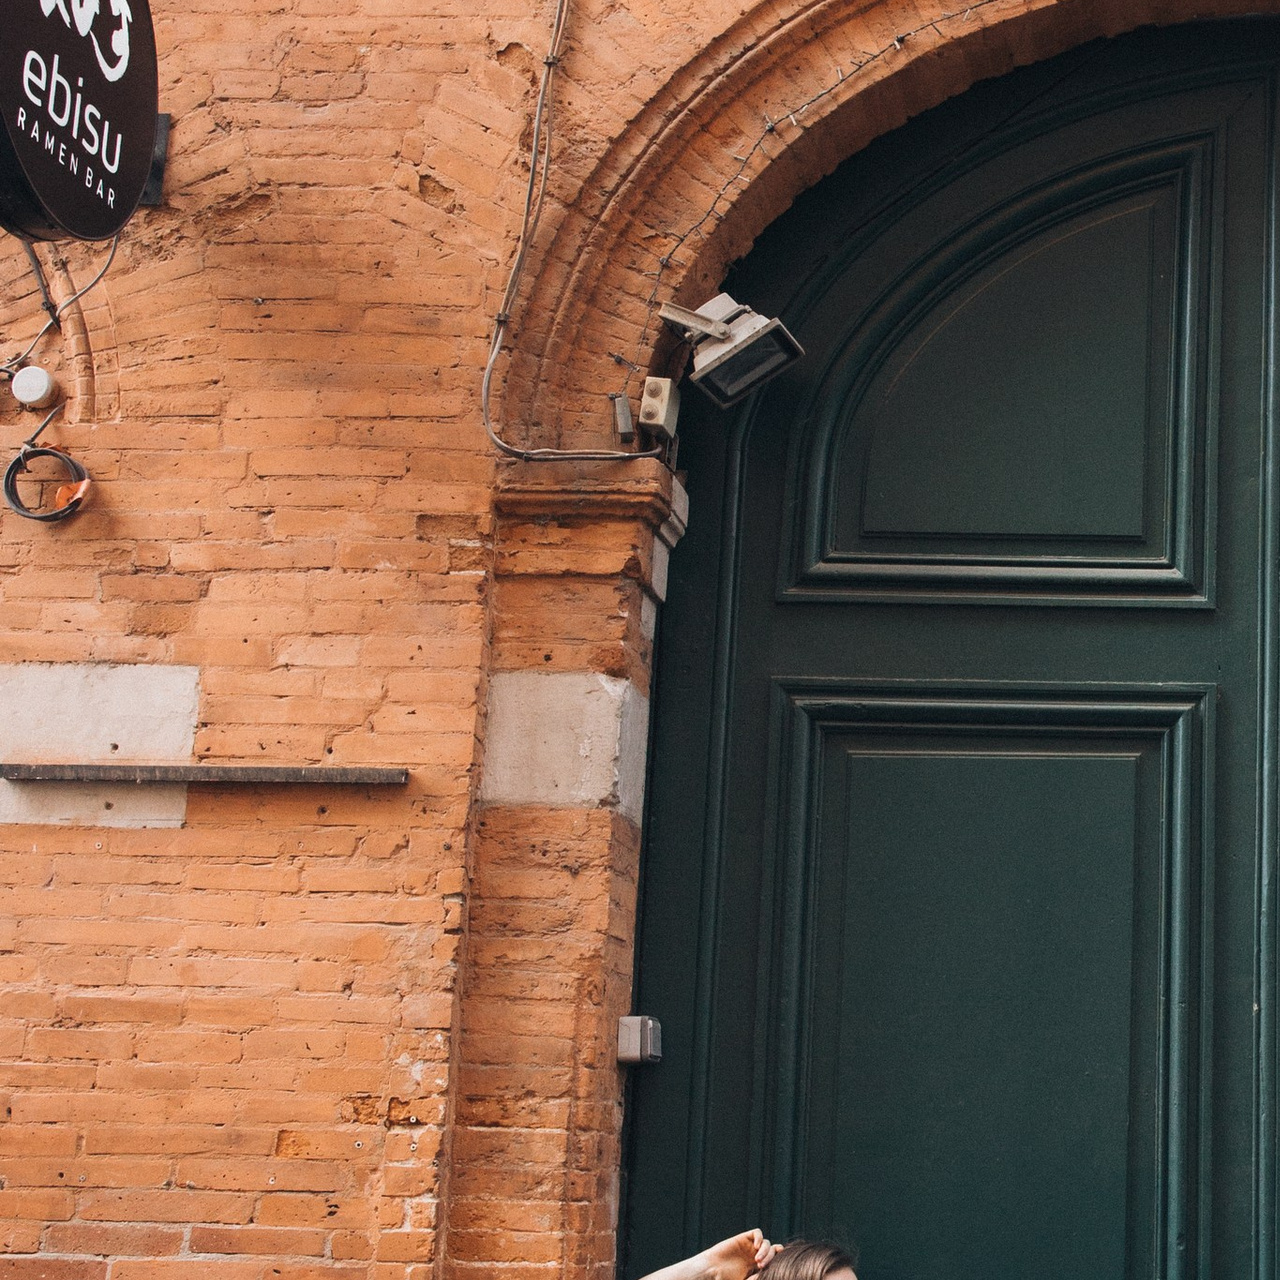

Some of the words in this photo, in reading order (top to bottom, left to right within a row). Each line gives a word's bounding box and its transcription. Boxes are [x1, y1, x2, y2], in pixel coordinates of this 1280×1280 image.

[17, 107, 79, 175] RAMEN
[85, 166, 115, 209] BAR
[23, 50, 122, 174] ebisu
